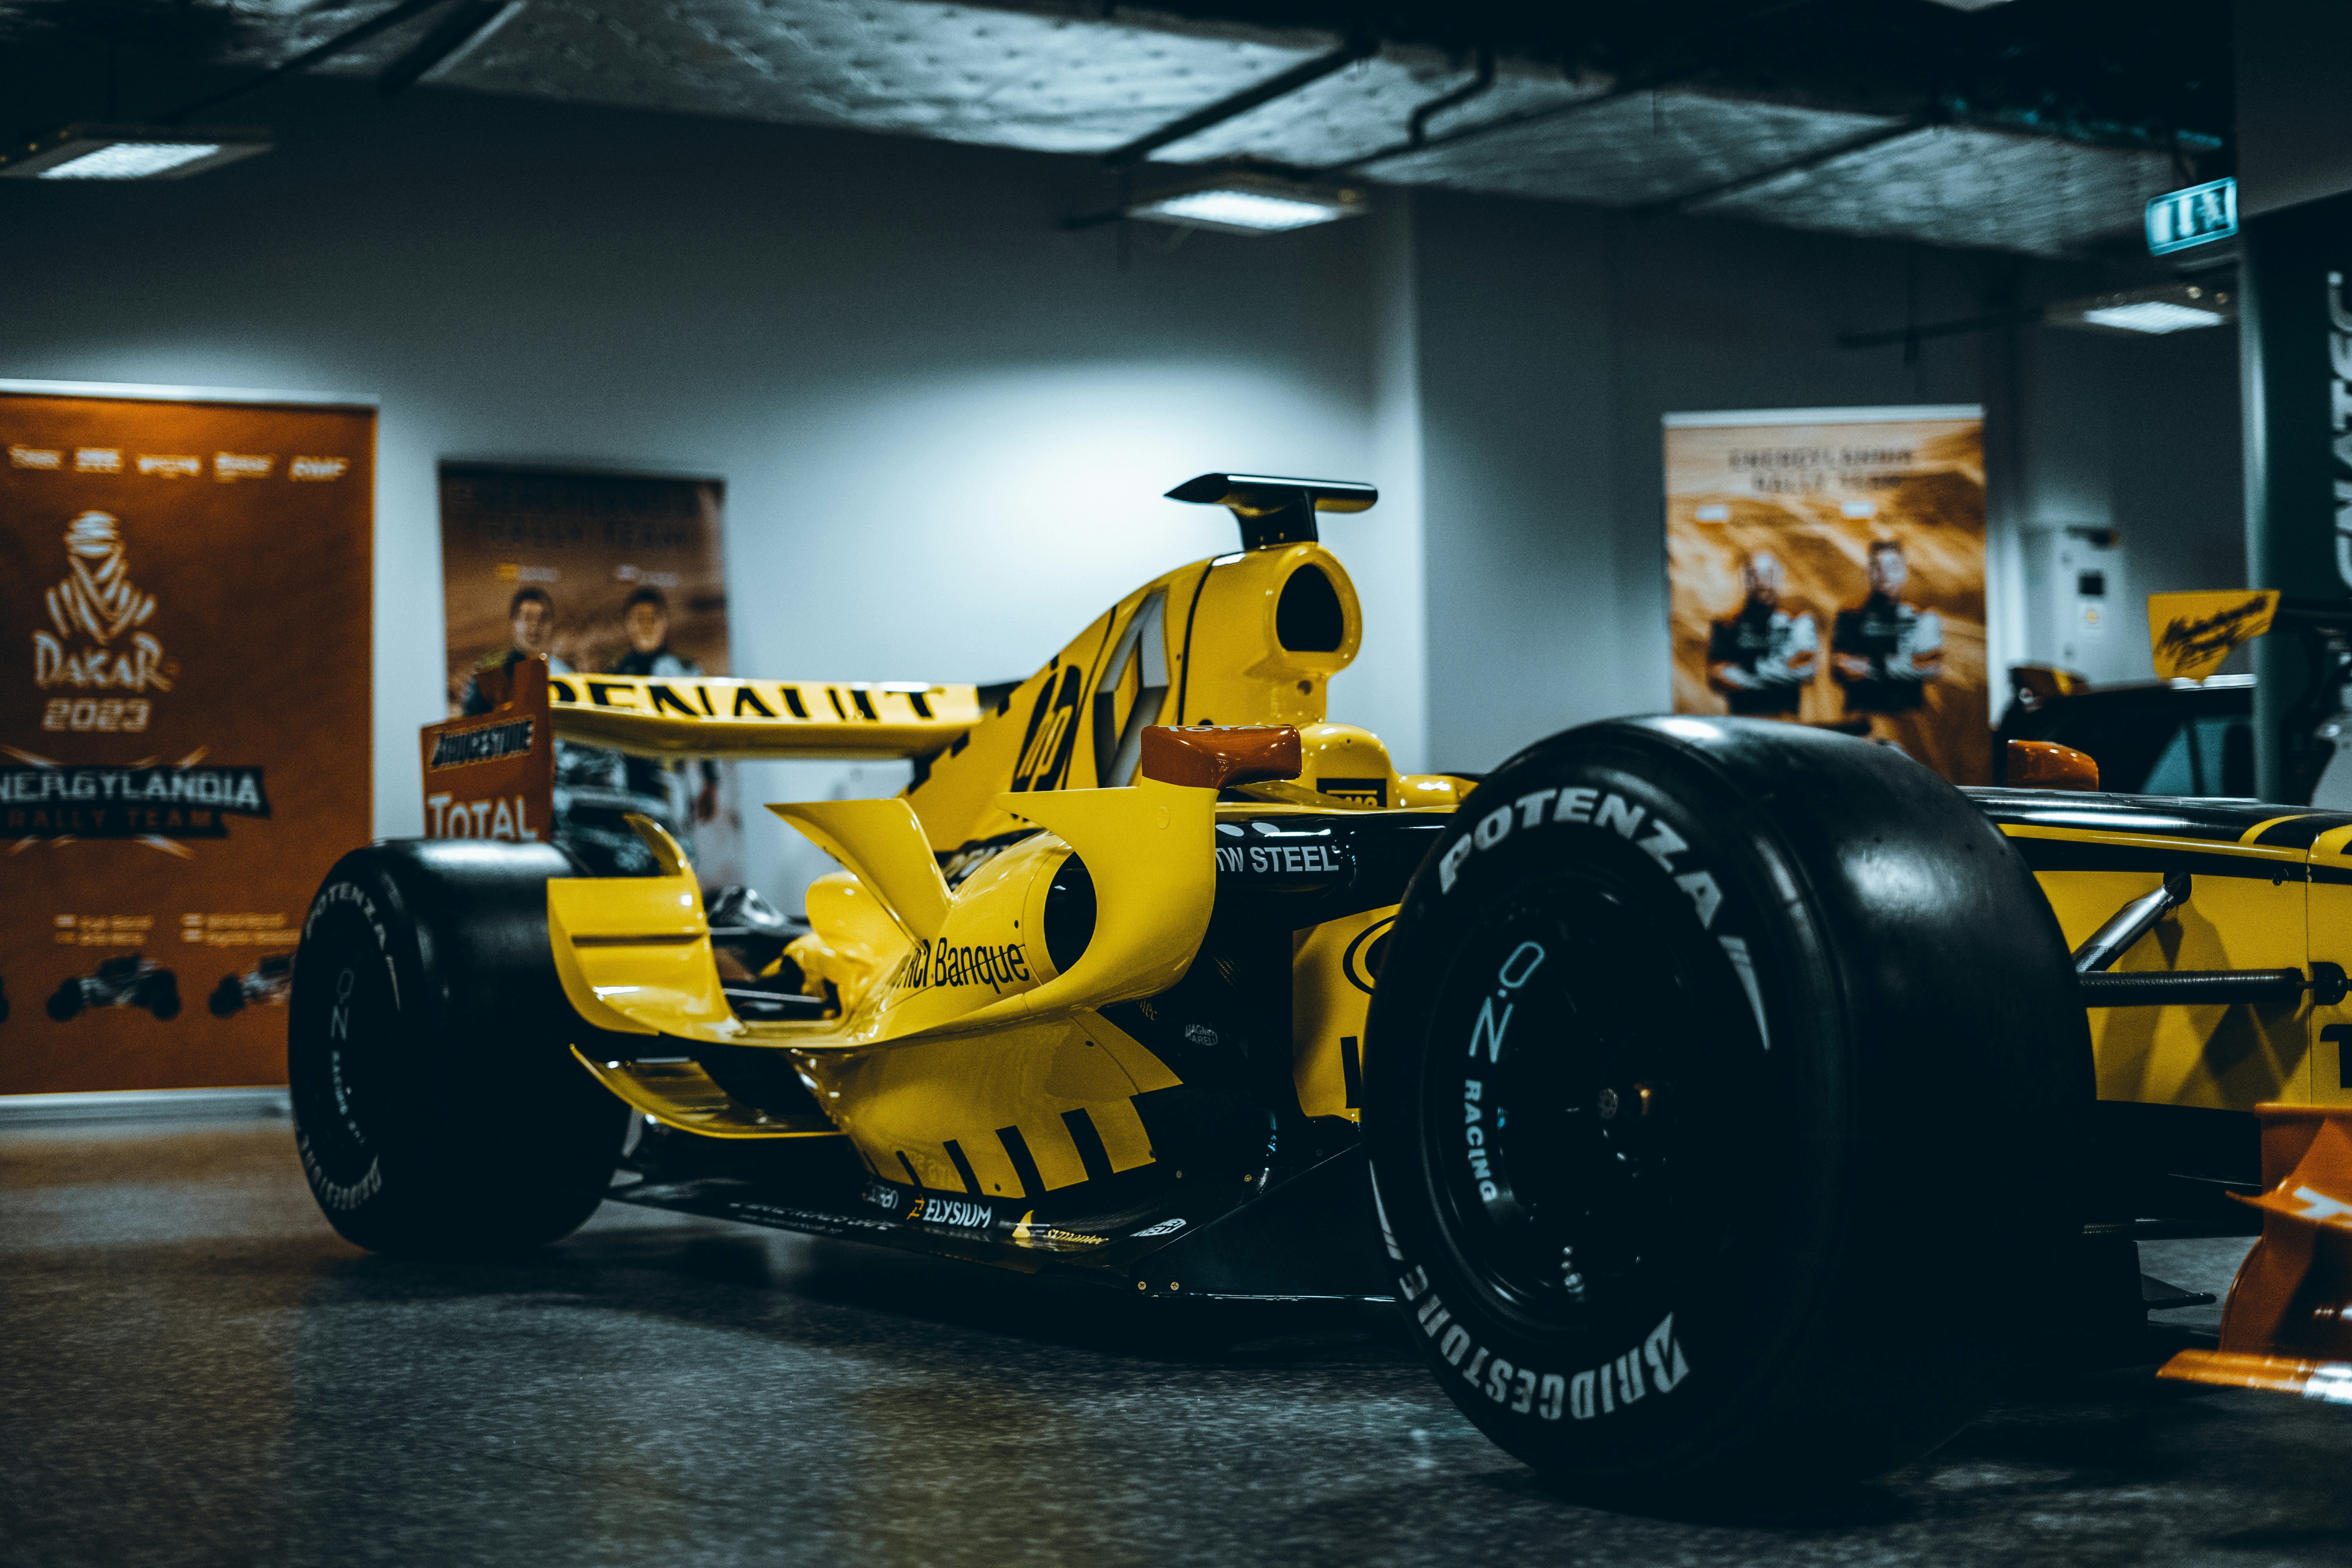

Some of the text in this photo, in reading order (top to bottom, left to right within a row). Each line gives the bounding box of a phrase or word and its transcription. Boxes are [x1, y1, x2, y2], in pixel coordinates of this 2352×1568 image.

[33, 631, 171, 691] DAKAR
[43, 698, 151, 732] 2023
[7, 806, 213, 830] RALLY TEAM
[429, 795, 537, 838] TOTAL
[1249, 846, 1339, 873] STEEL
[1438, 786, 1725, 931] POTENZA
[935, 937, 1029, 994] Banque
[1464, 1078, 1498, 1203] RACING
[922, 1198, 992, 1229] ELYSIUM
[1398, 1264, 1691, 1421] BRIDGESTONE
